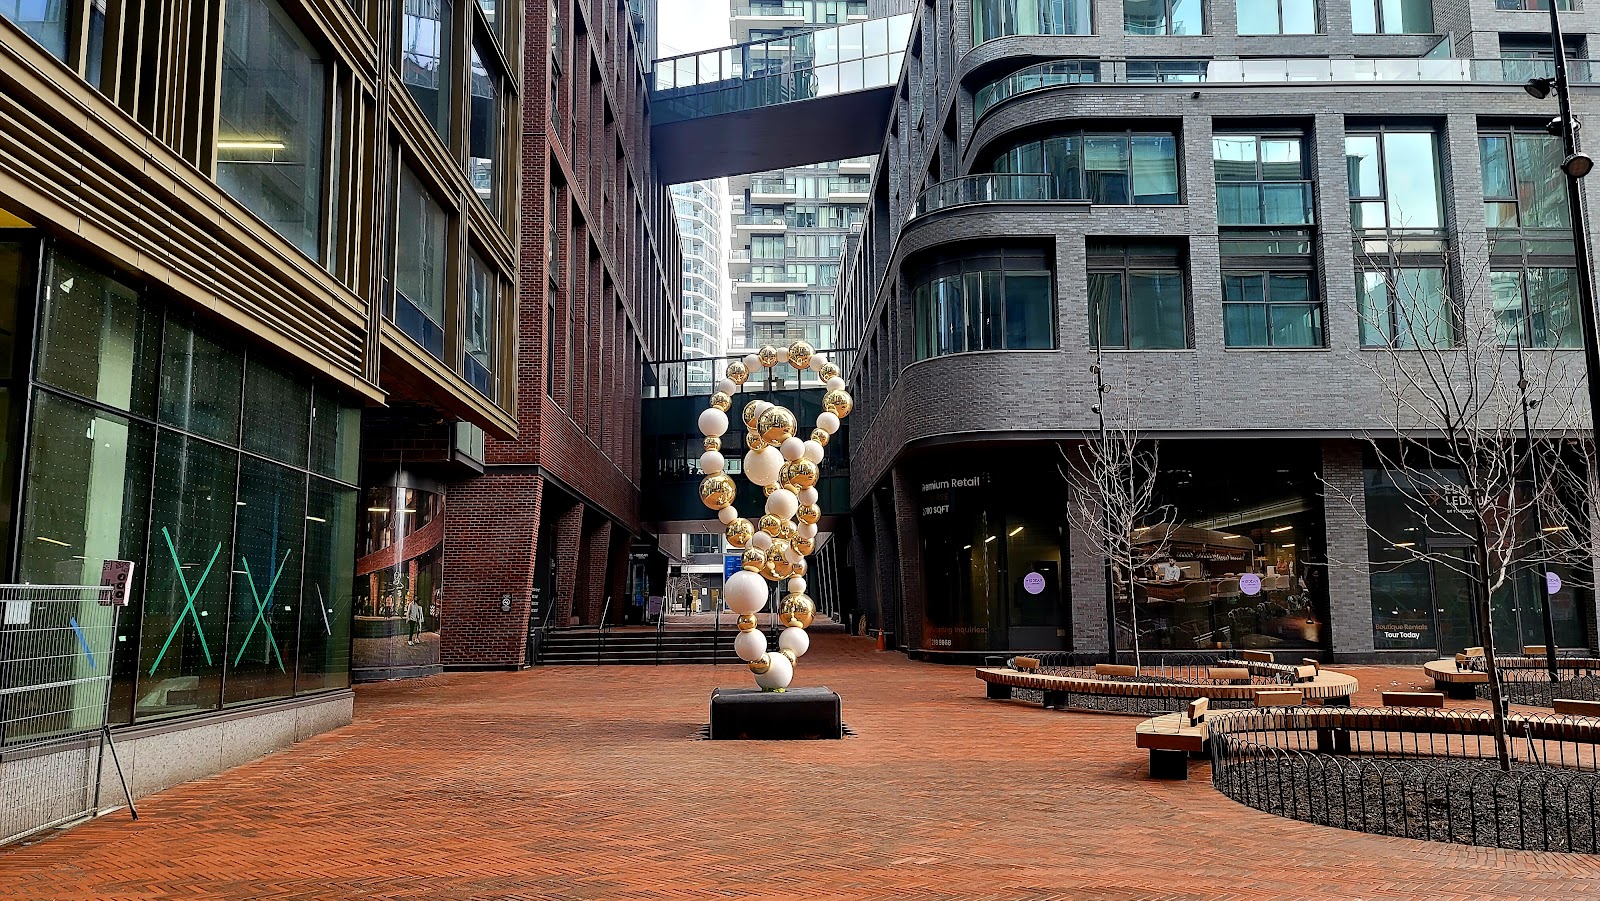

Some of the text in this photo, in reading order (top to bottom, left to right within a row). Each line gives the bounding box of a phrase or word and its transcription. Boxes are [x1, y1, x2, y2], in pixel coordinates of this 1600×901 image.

[951, 477, 980, 488] Retail
[1375, 624, 1404, 632] Boutique
[1399, 631, 1420, 640] Today
